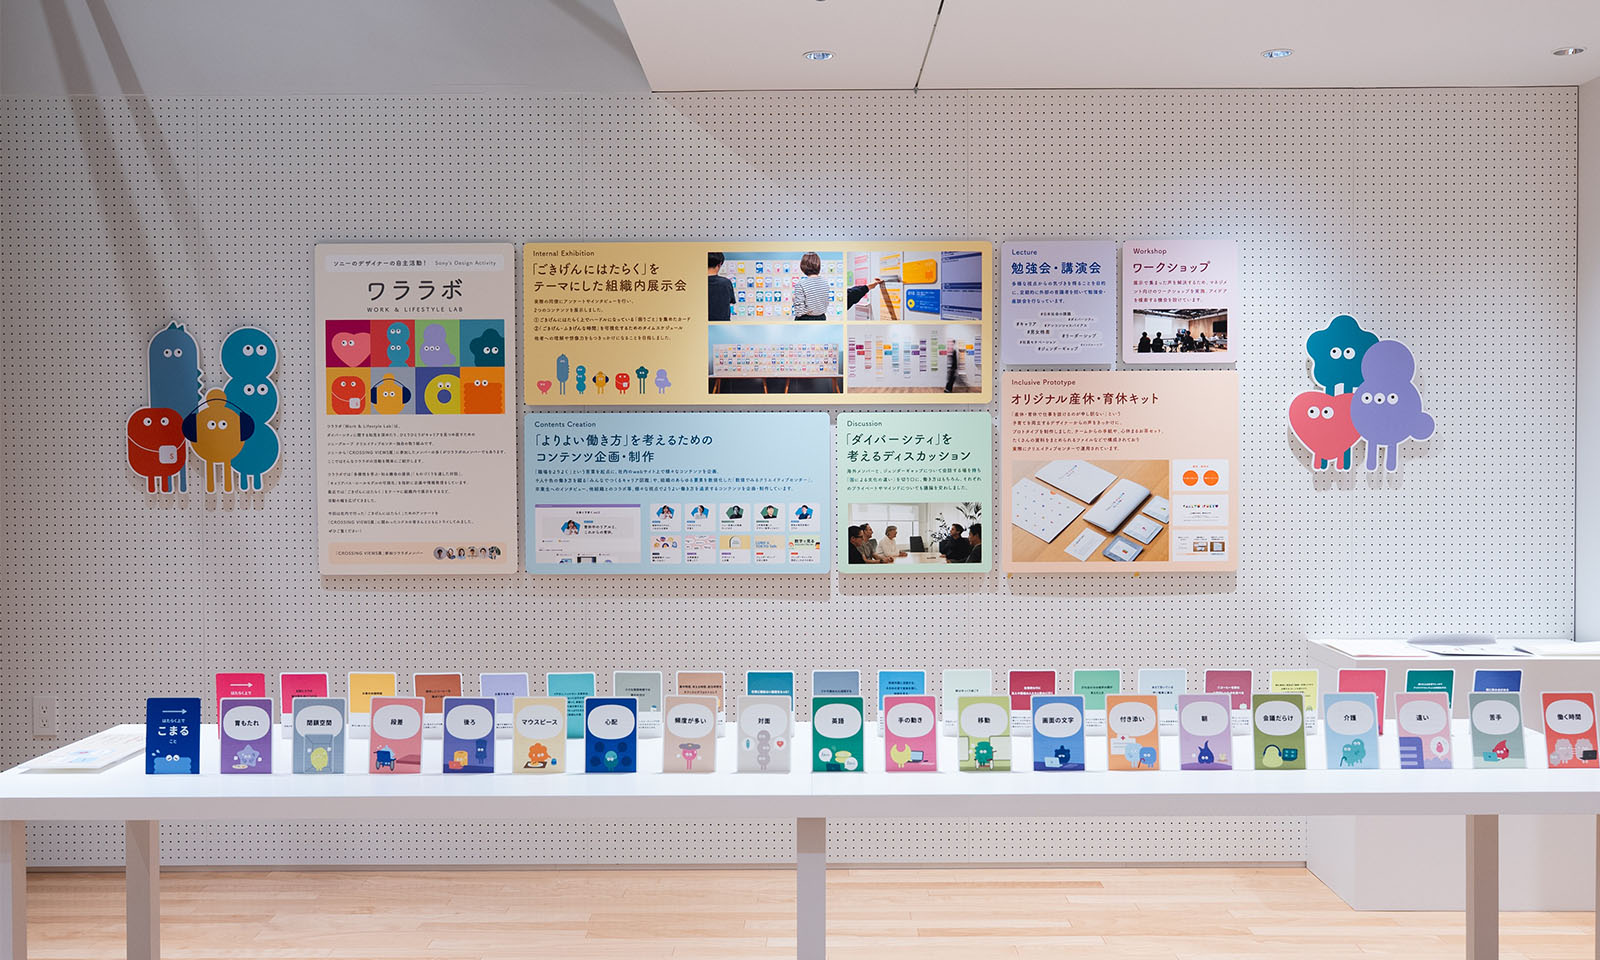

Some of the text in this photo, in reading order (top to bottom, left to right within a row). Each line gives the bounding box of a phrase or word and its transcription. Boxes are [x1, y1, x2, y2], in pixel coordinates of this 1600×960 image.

[533, 263, 659, 275] 「ごきげんにはたらく」を
[1011, 262, 1101, 274] 勉強会・講演会
[1133, 261, 1210, 273] ワークショップ
[369, 279, 463, 300] ワララボ
[534, 280, 686, 292] テーマにした組織内展示会
[1012, 393, 1158, 405] オリジナル産休・育休キット
[536, 434, 713, 446] 「よりよい働き方」を考えるための
[847, 433, 952, 445] 「ダイバーシティ」を
[537, 451, 654, 462] コンテンツ企画・制作
[847, 450, 970, 462] 考えるディスカッション
[605, 718, 618, 726] 心配
[158, 726, 189, 736] こまる
